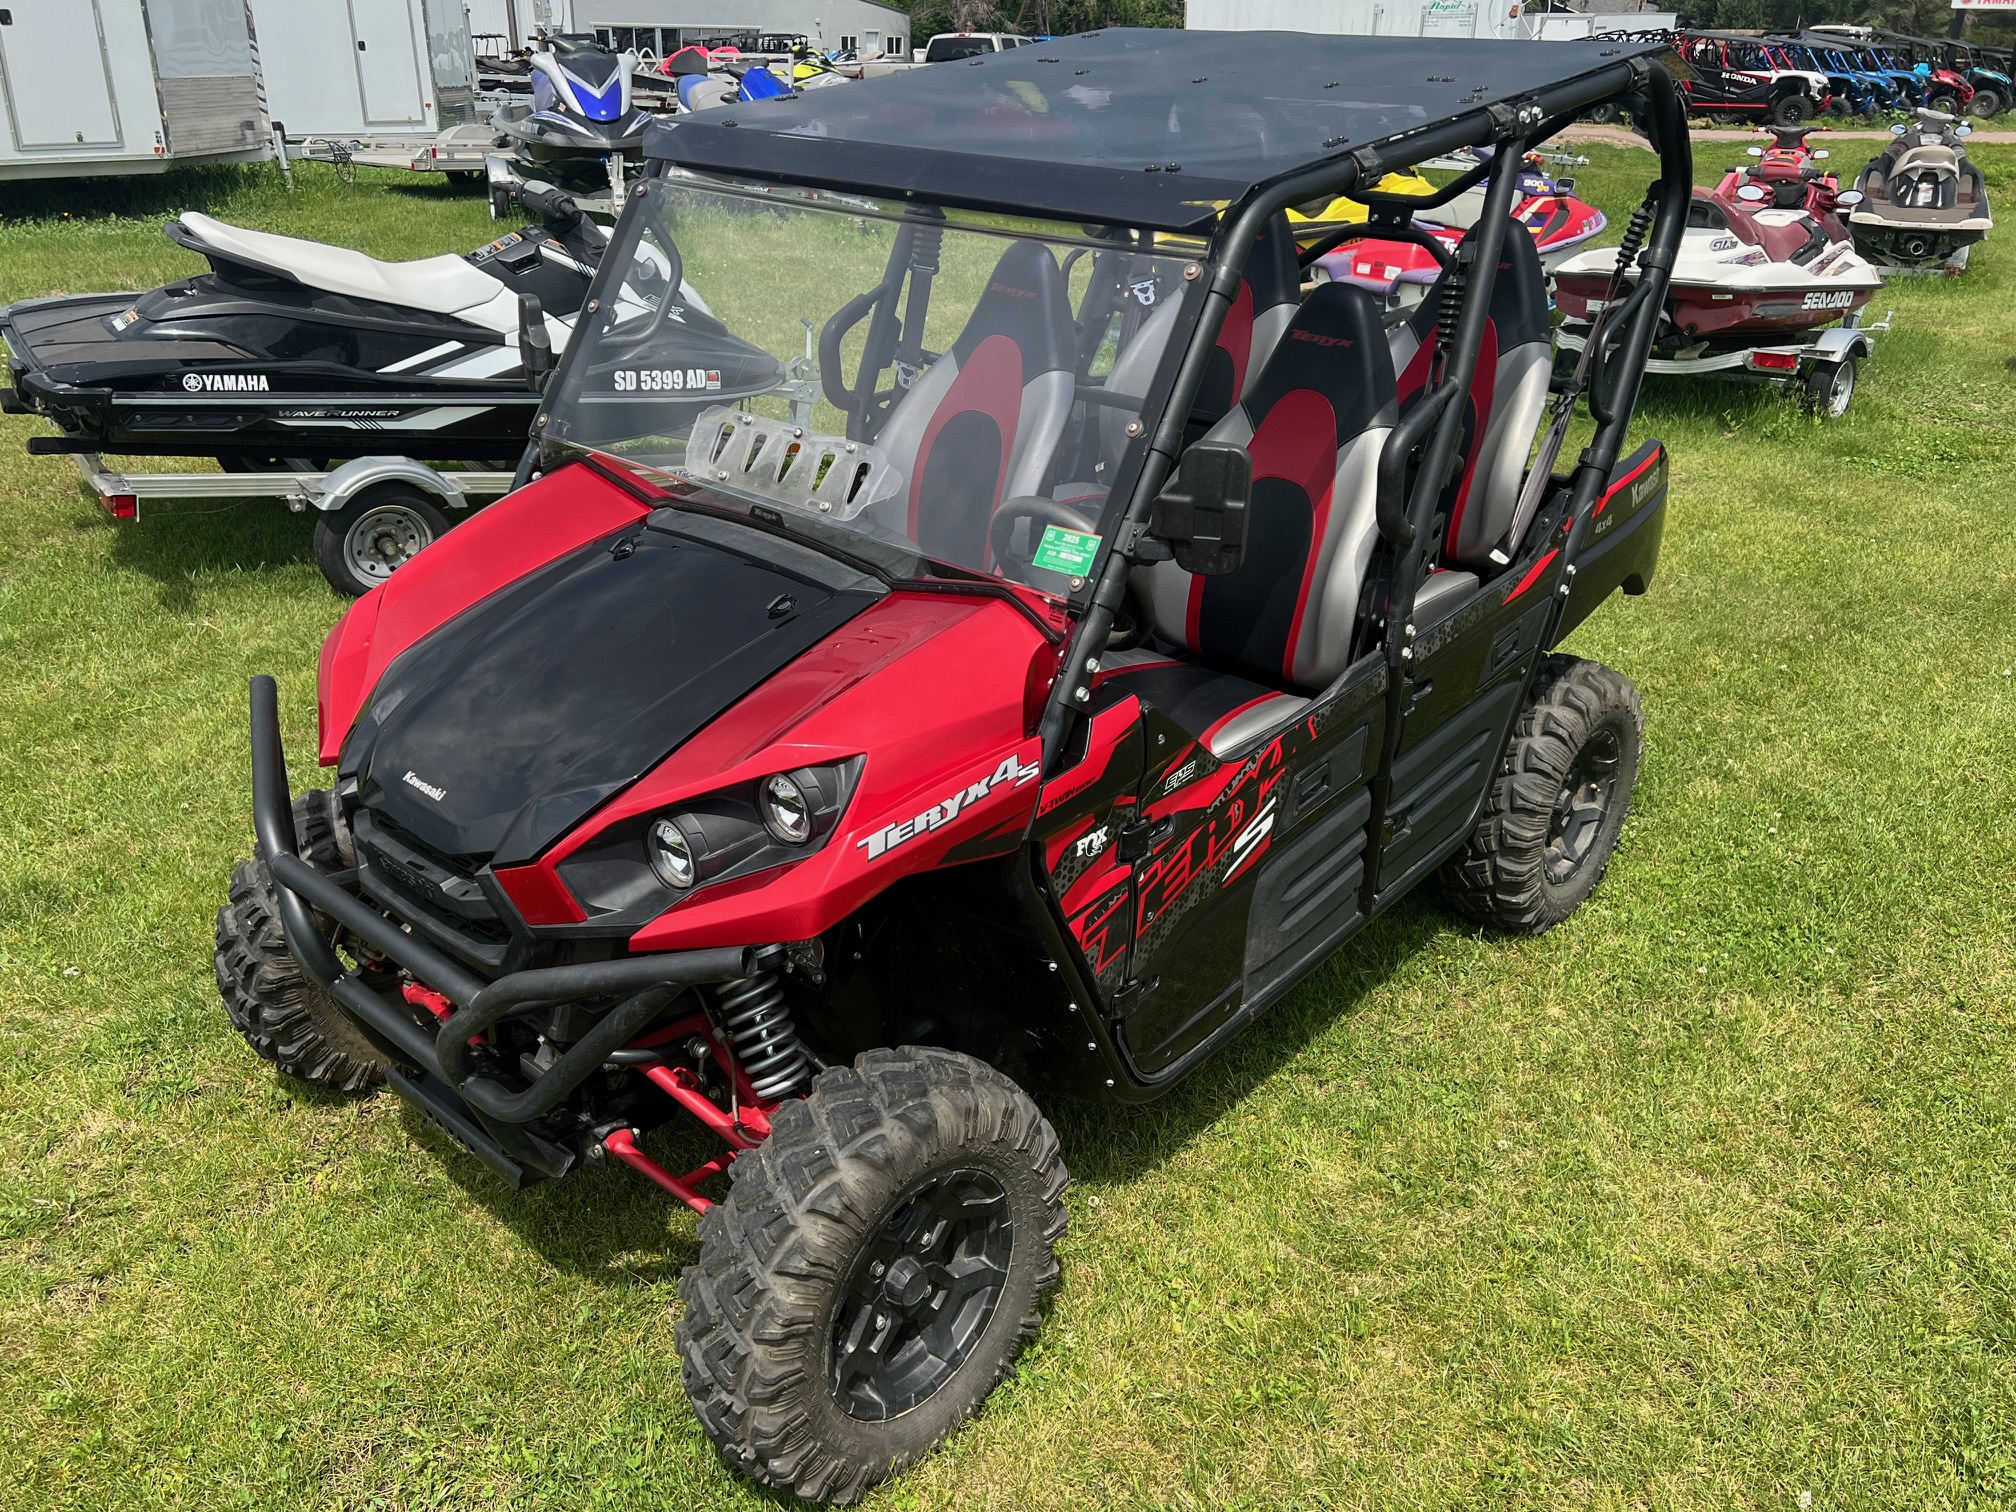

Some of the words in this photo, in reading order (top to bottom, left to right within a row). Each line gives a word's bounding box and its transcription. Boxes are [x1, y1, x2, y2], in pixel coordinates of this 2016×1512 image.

[1430, 2, 1460, 11] Rapid
[1721, 72, 1757, 84] HONDA
[1523, 179, 1543, 187] 900
[202, 375, 269, 391] YAMAHA
[614, 370, 637, 390] SD
[640, 370, 684, 390] 5399
[686, 369, 706, 389] AD
[1062, 533, 1080, 545] 2025
[402, 770, 447, 802] Kawasaki
[1076, 825, 1109, 858] FOX
